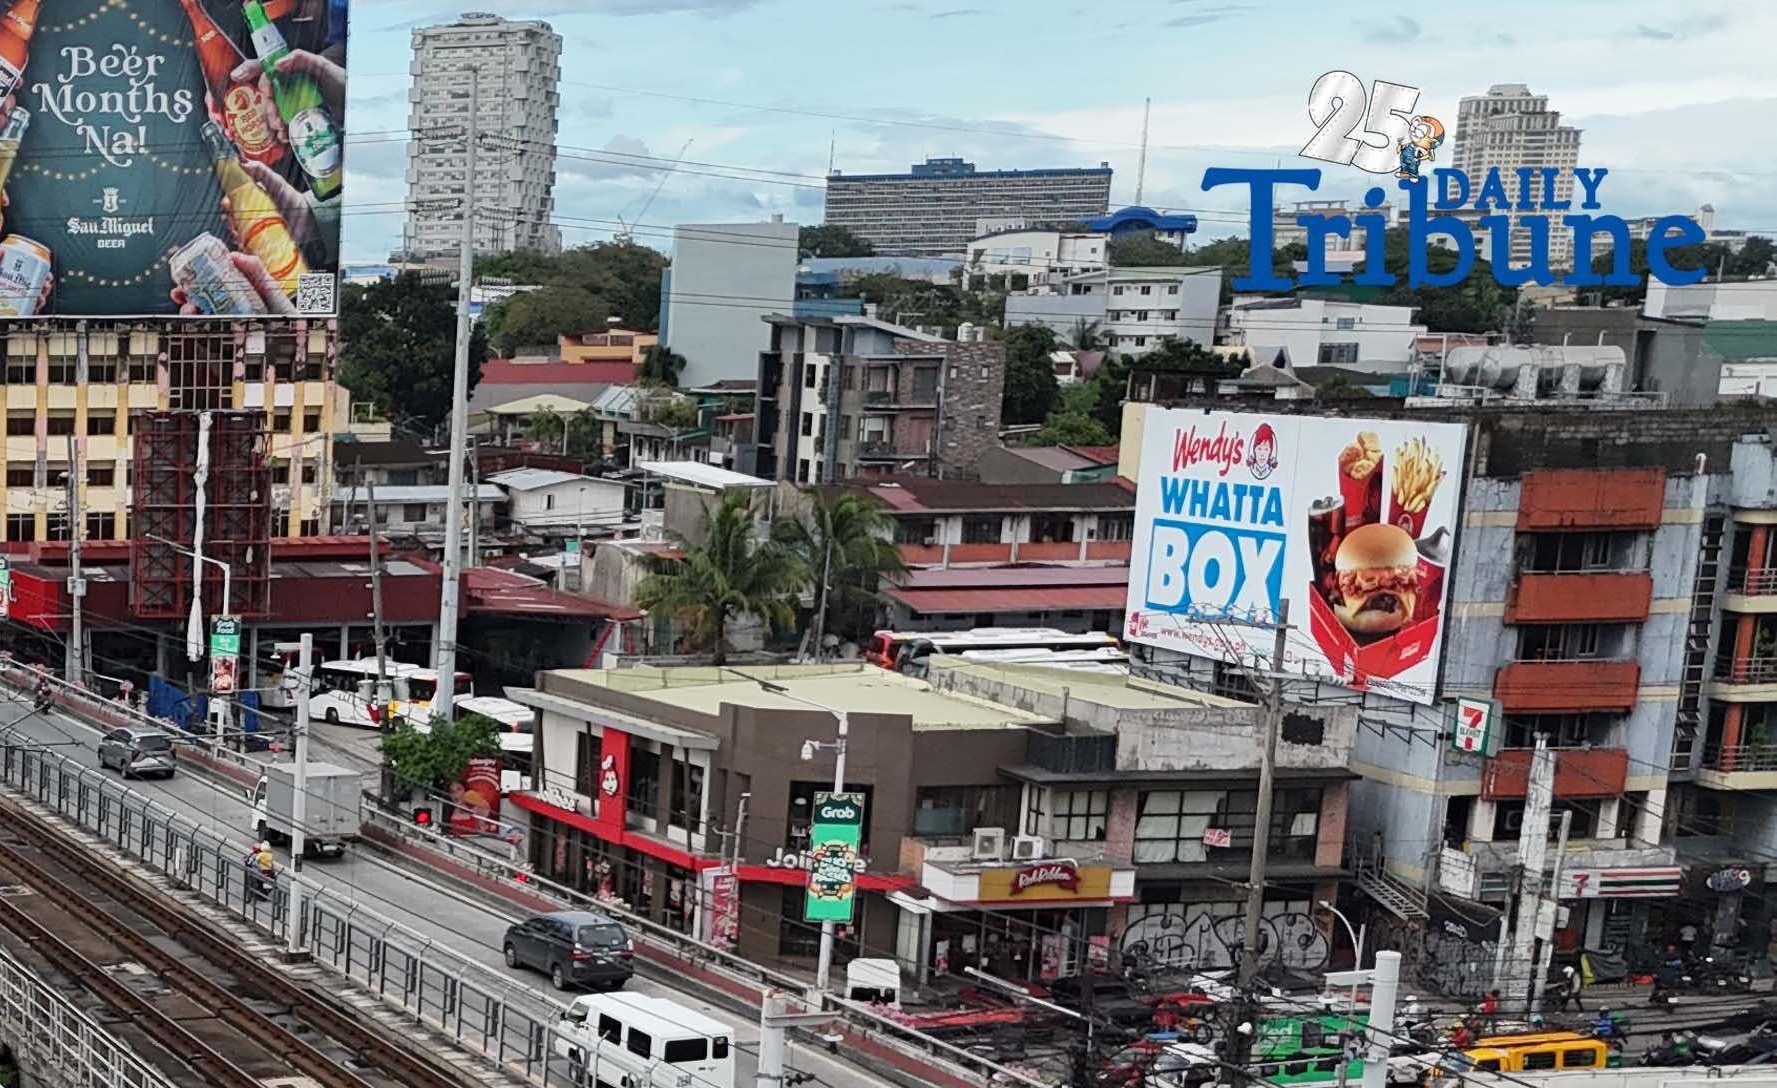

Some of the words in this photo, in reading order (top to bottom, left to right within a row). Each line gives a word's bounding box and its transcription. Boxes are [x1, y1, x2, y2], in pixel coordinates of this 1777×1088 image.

[57, 43, 165, 86] Beer
[31, 82, 193, 125] Months
[76, 125, 147, 167] Na!
[66, 217, 99, 235] San
[99, 216, 155, 237] Miguel
[97, 239, 126, 249] BEER
[1172, 420, 1245, 476] Wendy's
[1160, 476, 1285, 527] WHATTA
[1147, 523, 1285, 620] BOX
[821, 806, 855, 819] Grab
